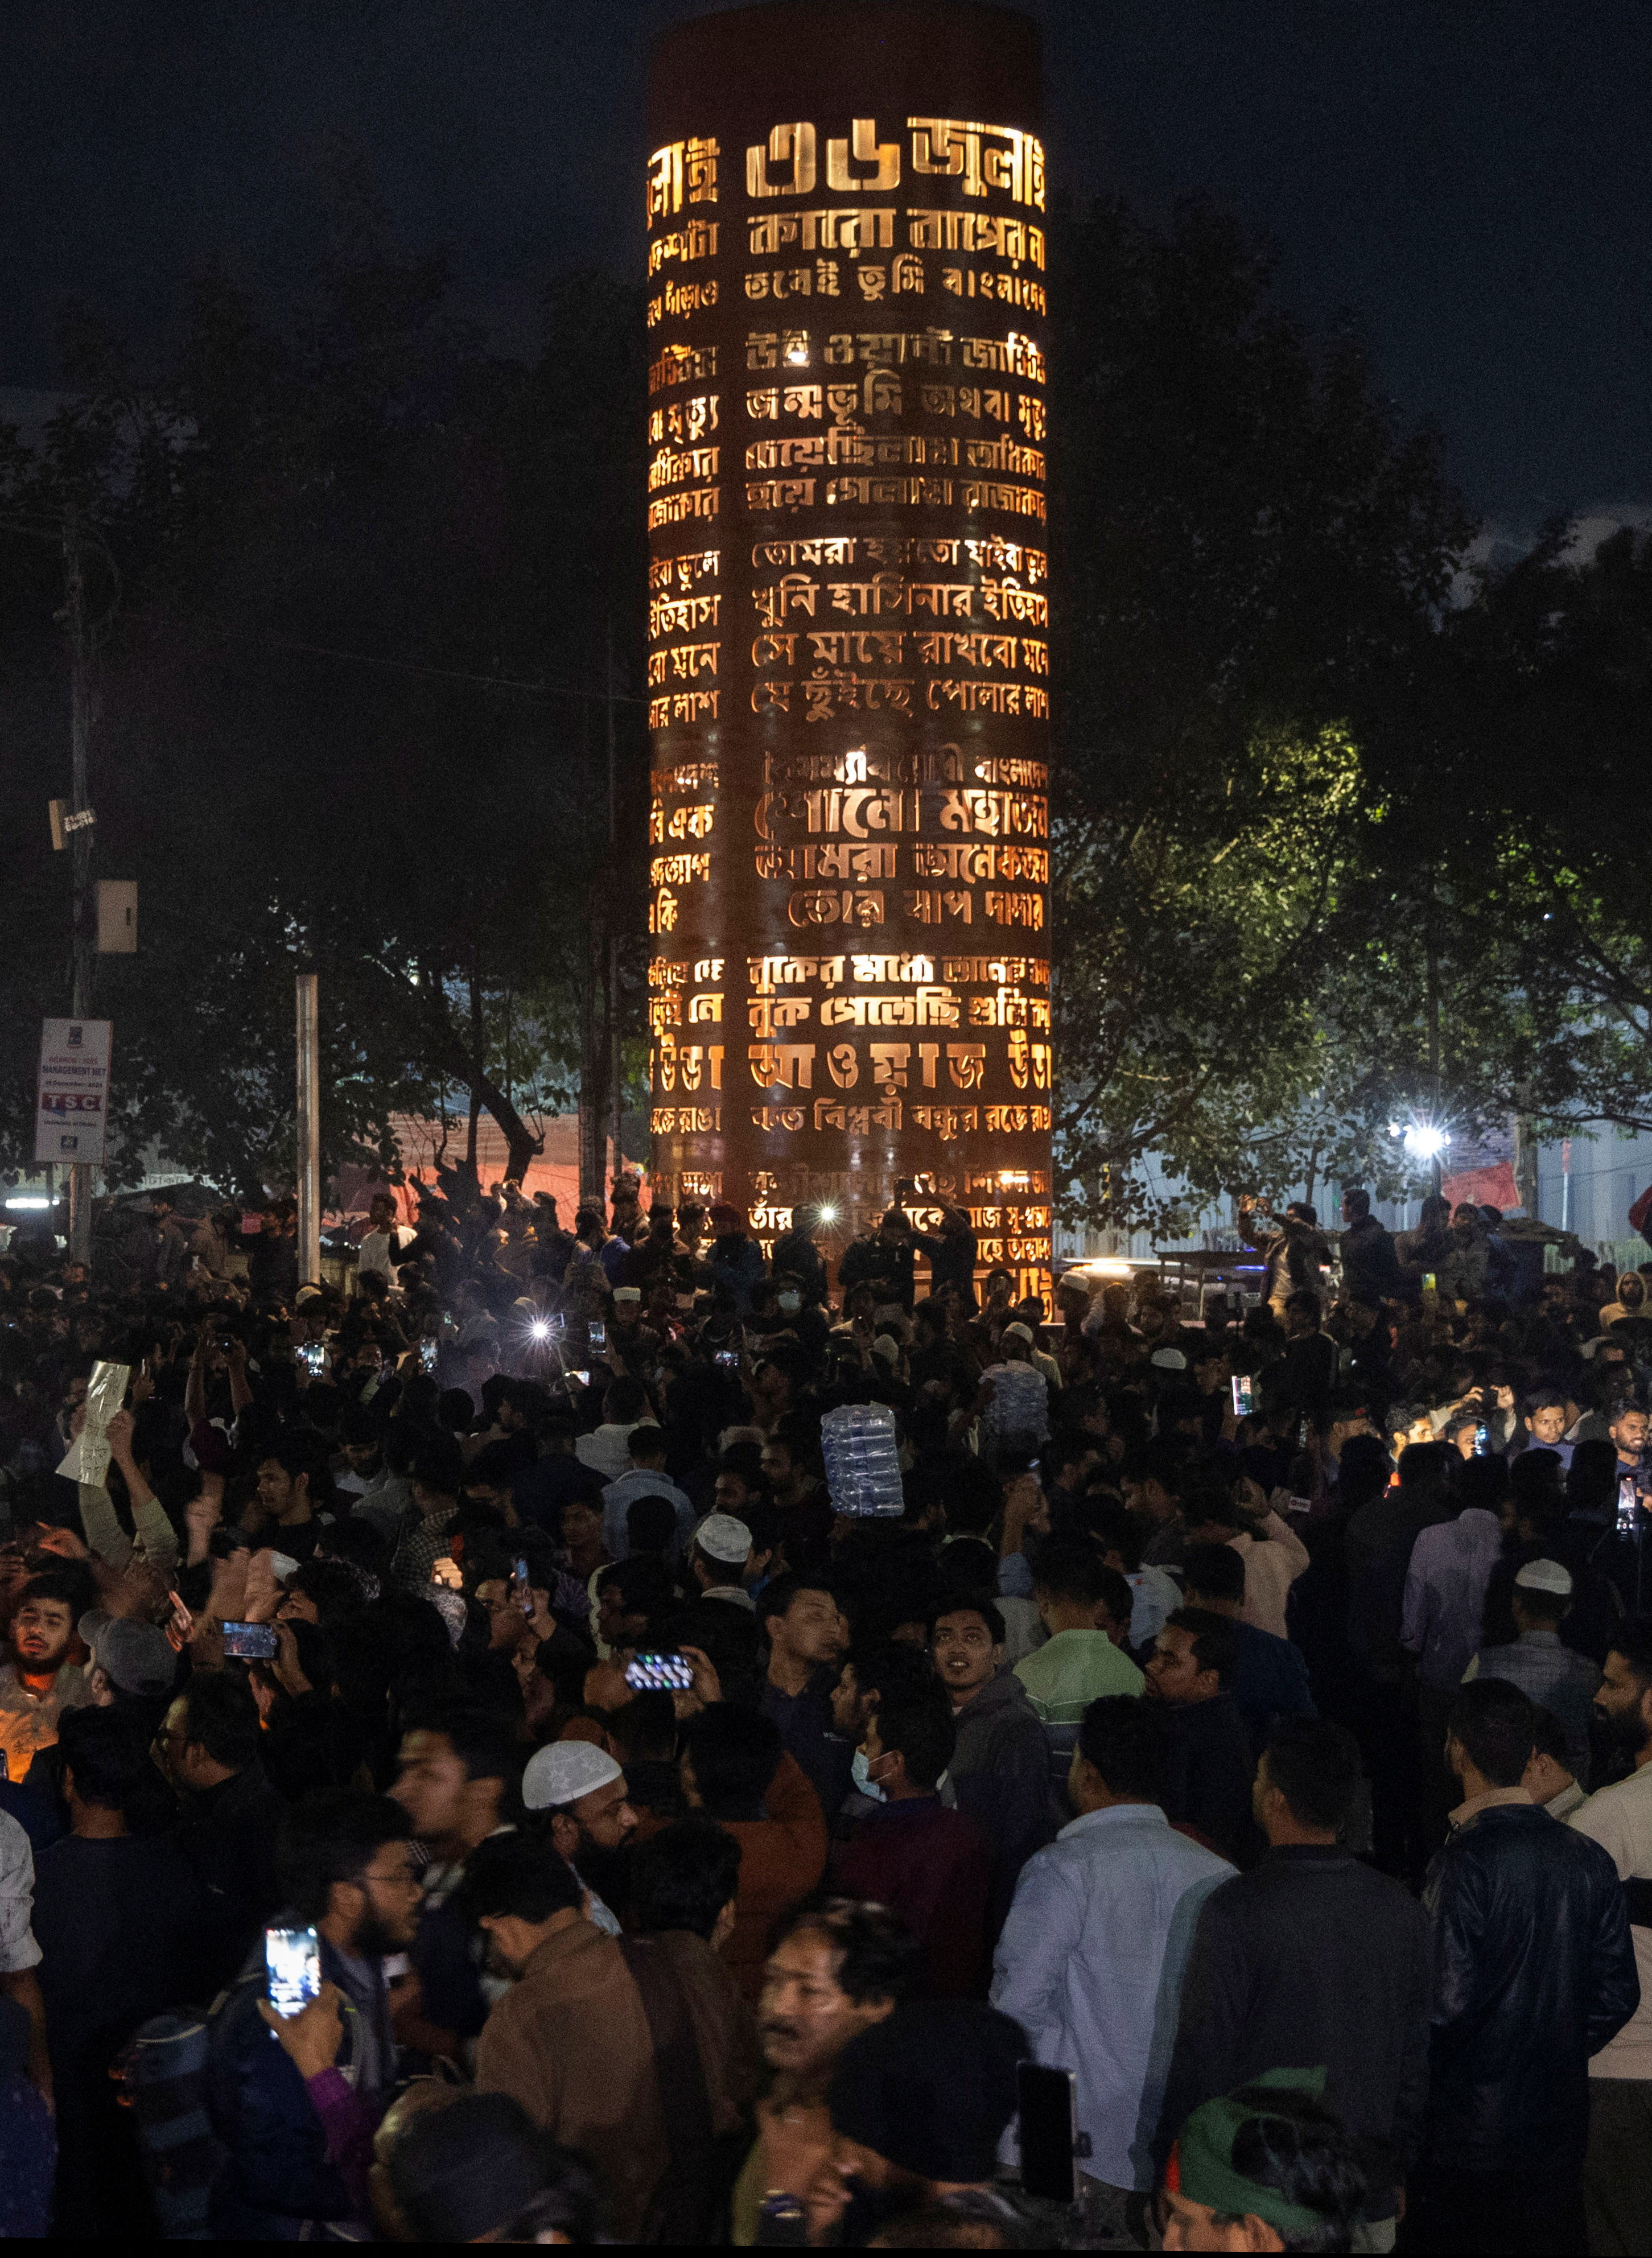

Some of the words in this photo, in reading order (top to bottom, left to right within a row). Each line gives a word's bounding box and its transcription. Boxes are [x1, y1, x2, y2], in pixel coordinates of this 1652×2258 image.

[907, 117, 1046, 213] জুলাই
[747, 208, 896, 258] কারো
[907, 208, 1025, 270] বাপের
[858, 253, 924, 301] তুমি
[746, 368, 902, 426] জন্মভূমি
[752, 537, 857, 568] তোমরা
[752, 572, 819, 628] খুনি
[827, 571, 975, 617] হাসিনার
[751, 633, 800, 667] সে
[912, 631, 1018, 670] রাখবো
[926, 679, 1021, 715] পোলার
[668, 804, 714, 840] এক
[747, 955, 846, 995] বুকের
[689, 993, 725, 1024] নে
[746, 996, 813, 1038] বুক
[820, 986, 962, 1029] পেতেছি
[748, 1043, 986, 1096] আওয়াজ
[48, 1094, 96, 1110] TSC
[813, 1097, 903, 1136] বিপ্লবী
